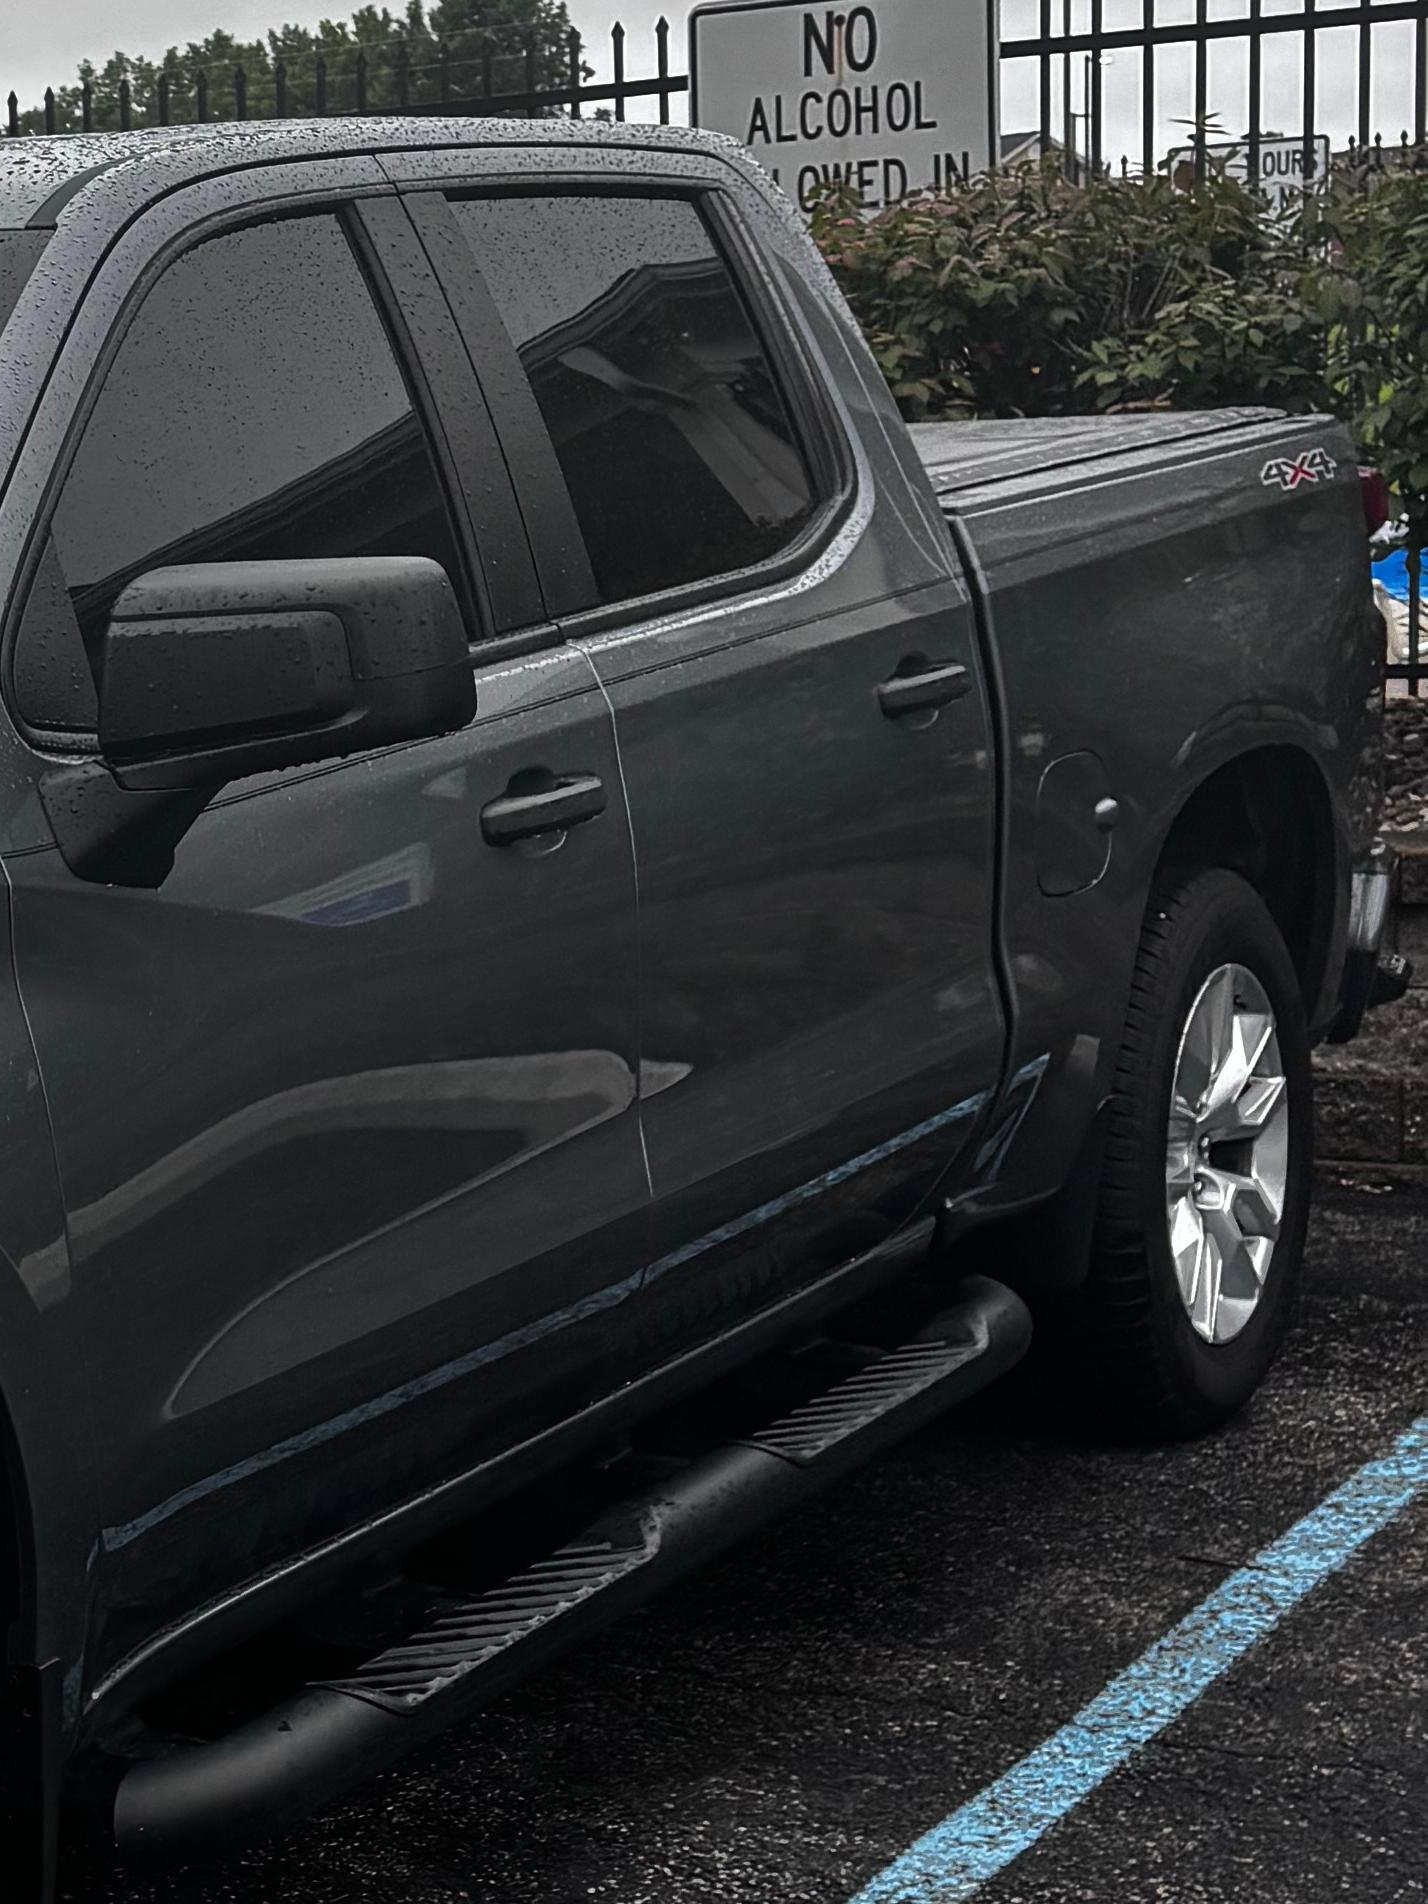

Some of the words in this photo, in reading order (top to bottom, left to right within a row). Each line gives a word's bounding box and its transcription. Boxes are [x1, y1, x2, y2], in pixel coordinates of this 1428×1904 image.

[803, 5, 877, 77] NO
[746, 81, 937, 145] ALCOHOL
[933, 151, 970, 191] IN
